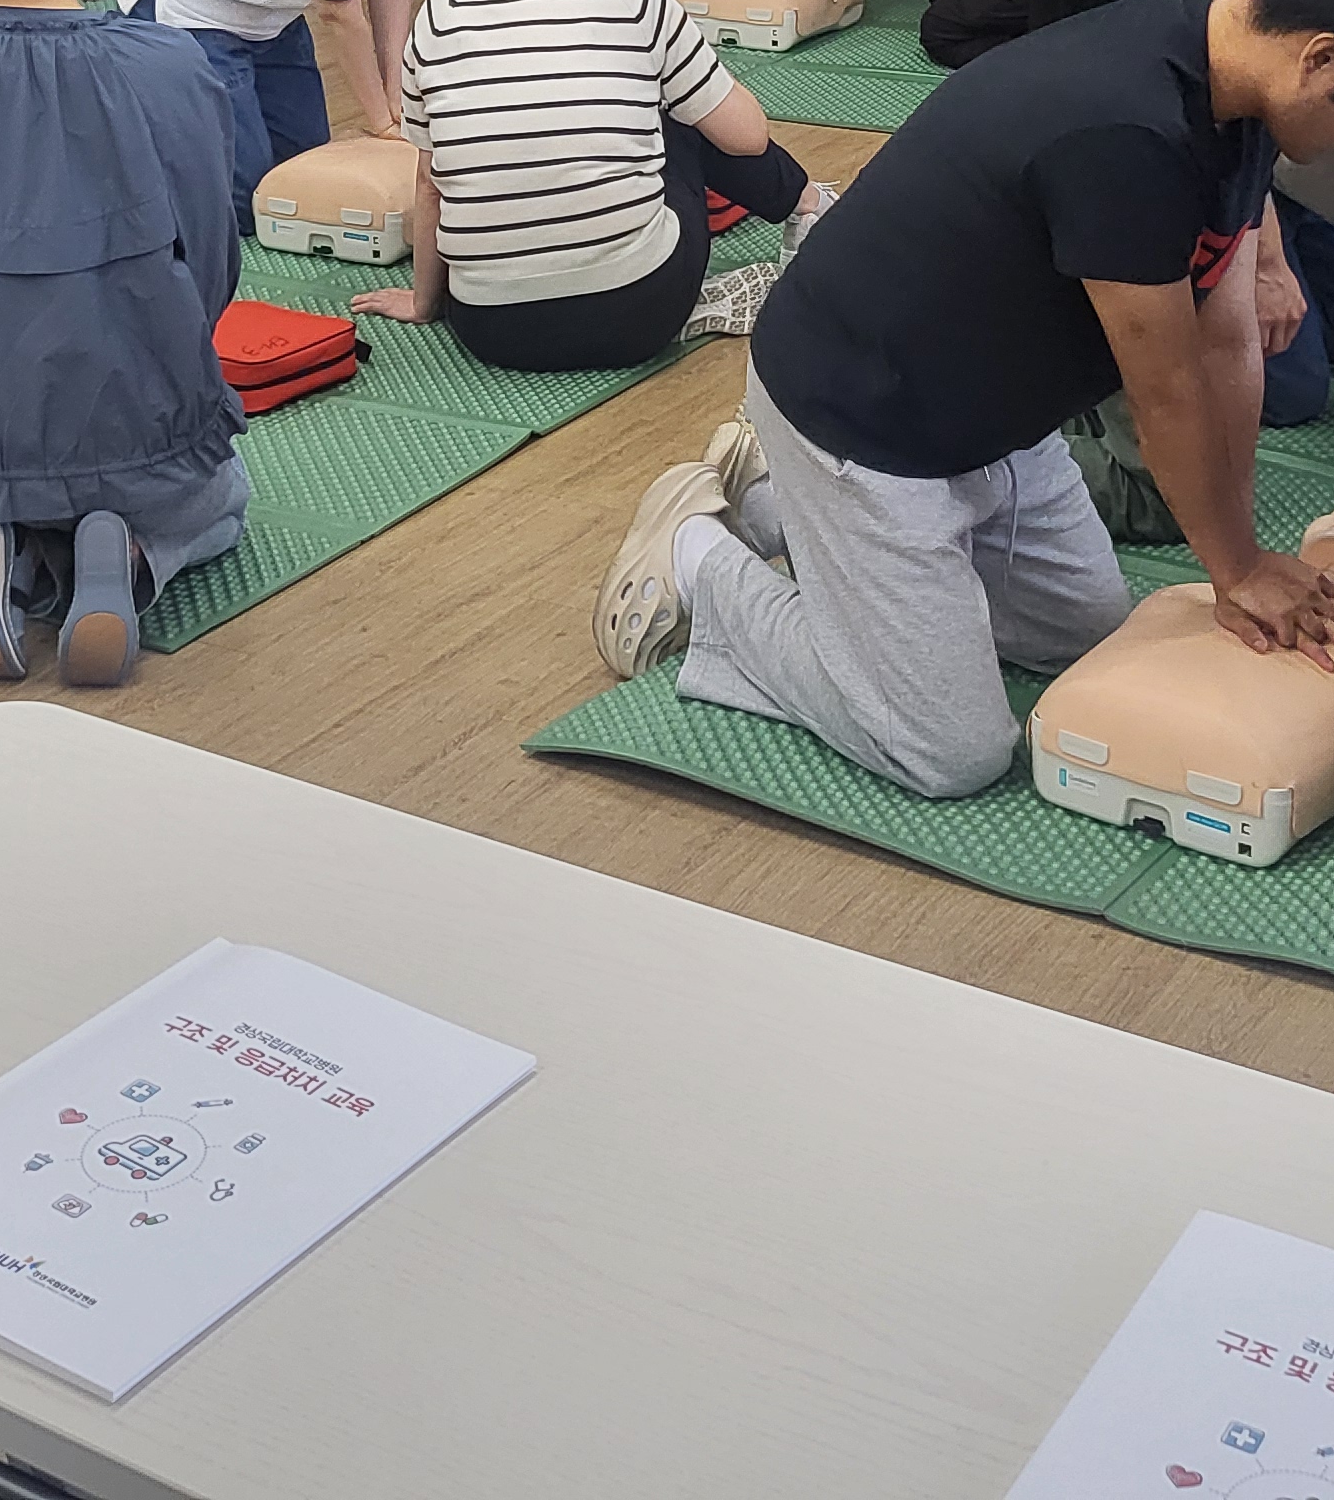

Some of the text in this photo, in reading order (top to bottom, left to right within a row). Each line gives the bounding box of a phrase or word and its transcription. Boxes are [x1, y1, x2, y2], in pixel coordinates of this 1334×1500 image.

[163, 1015, 377, 1120] 구조 및 응급처치 교육
[233, 1021, 345, 1077] 경상국립대학교병원
[1214, 1329, 1281, 1369] 구조
[1282, 1352, 1321, 1385] 및
